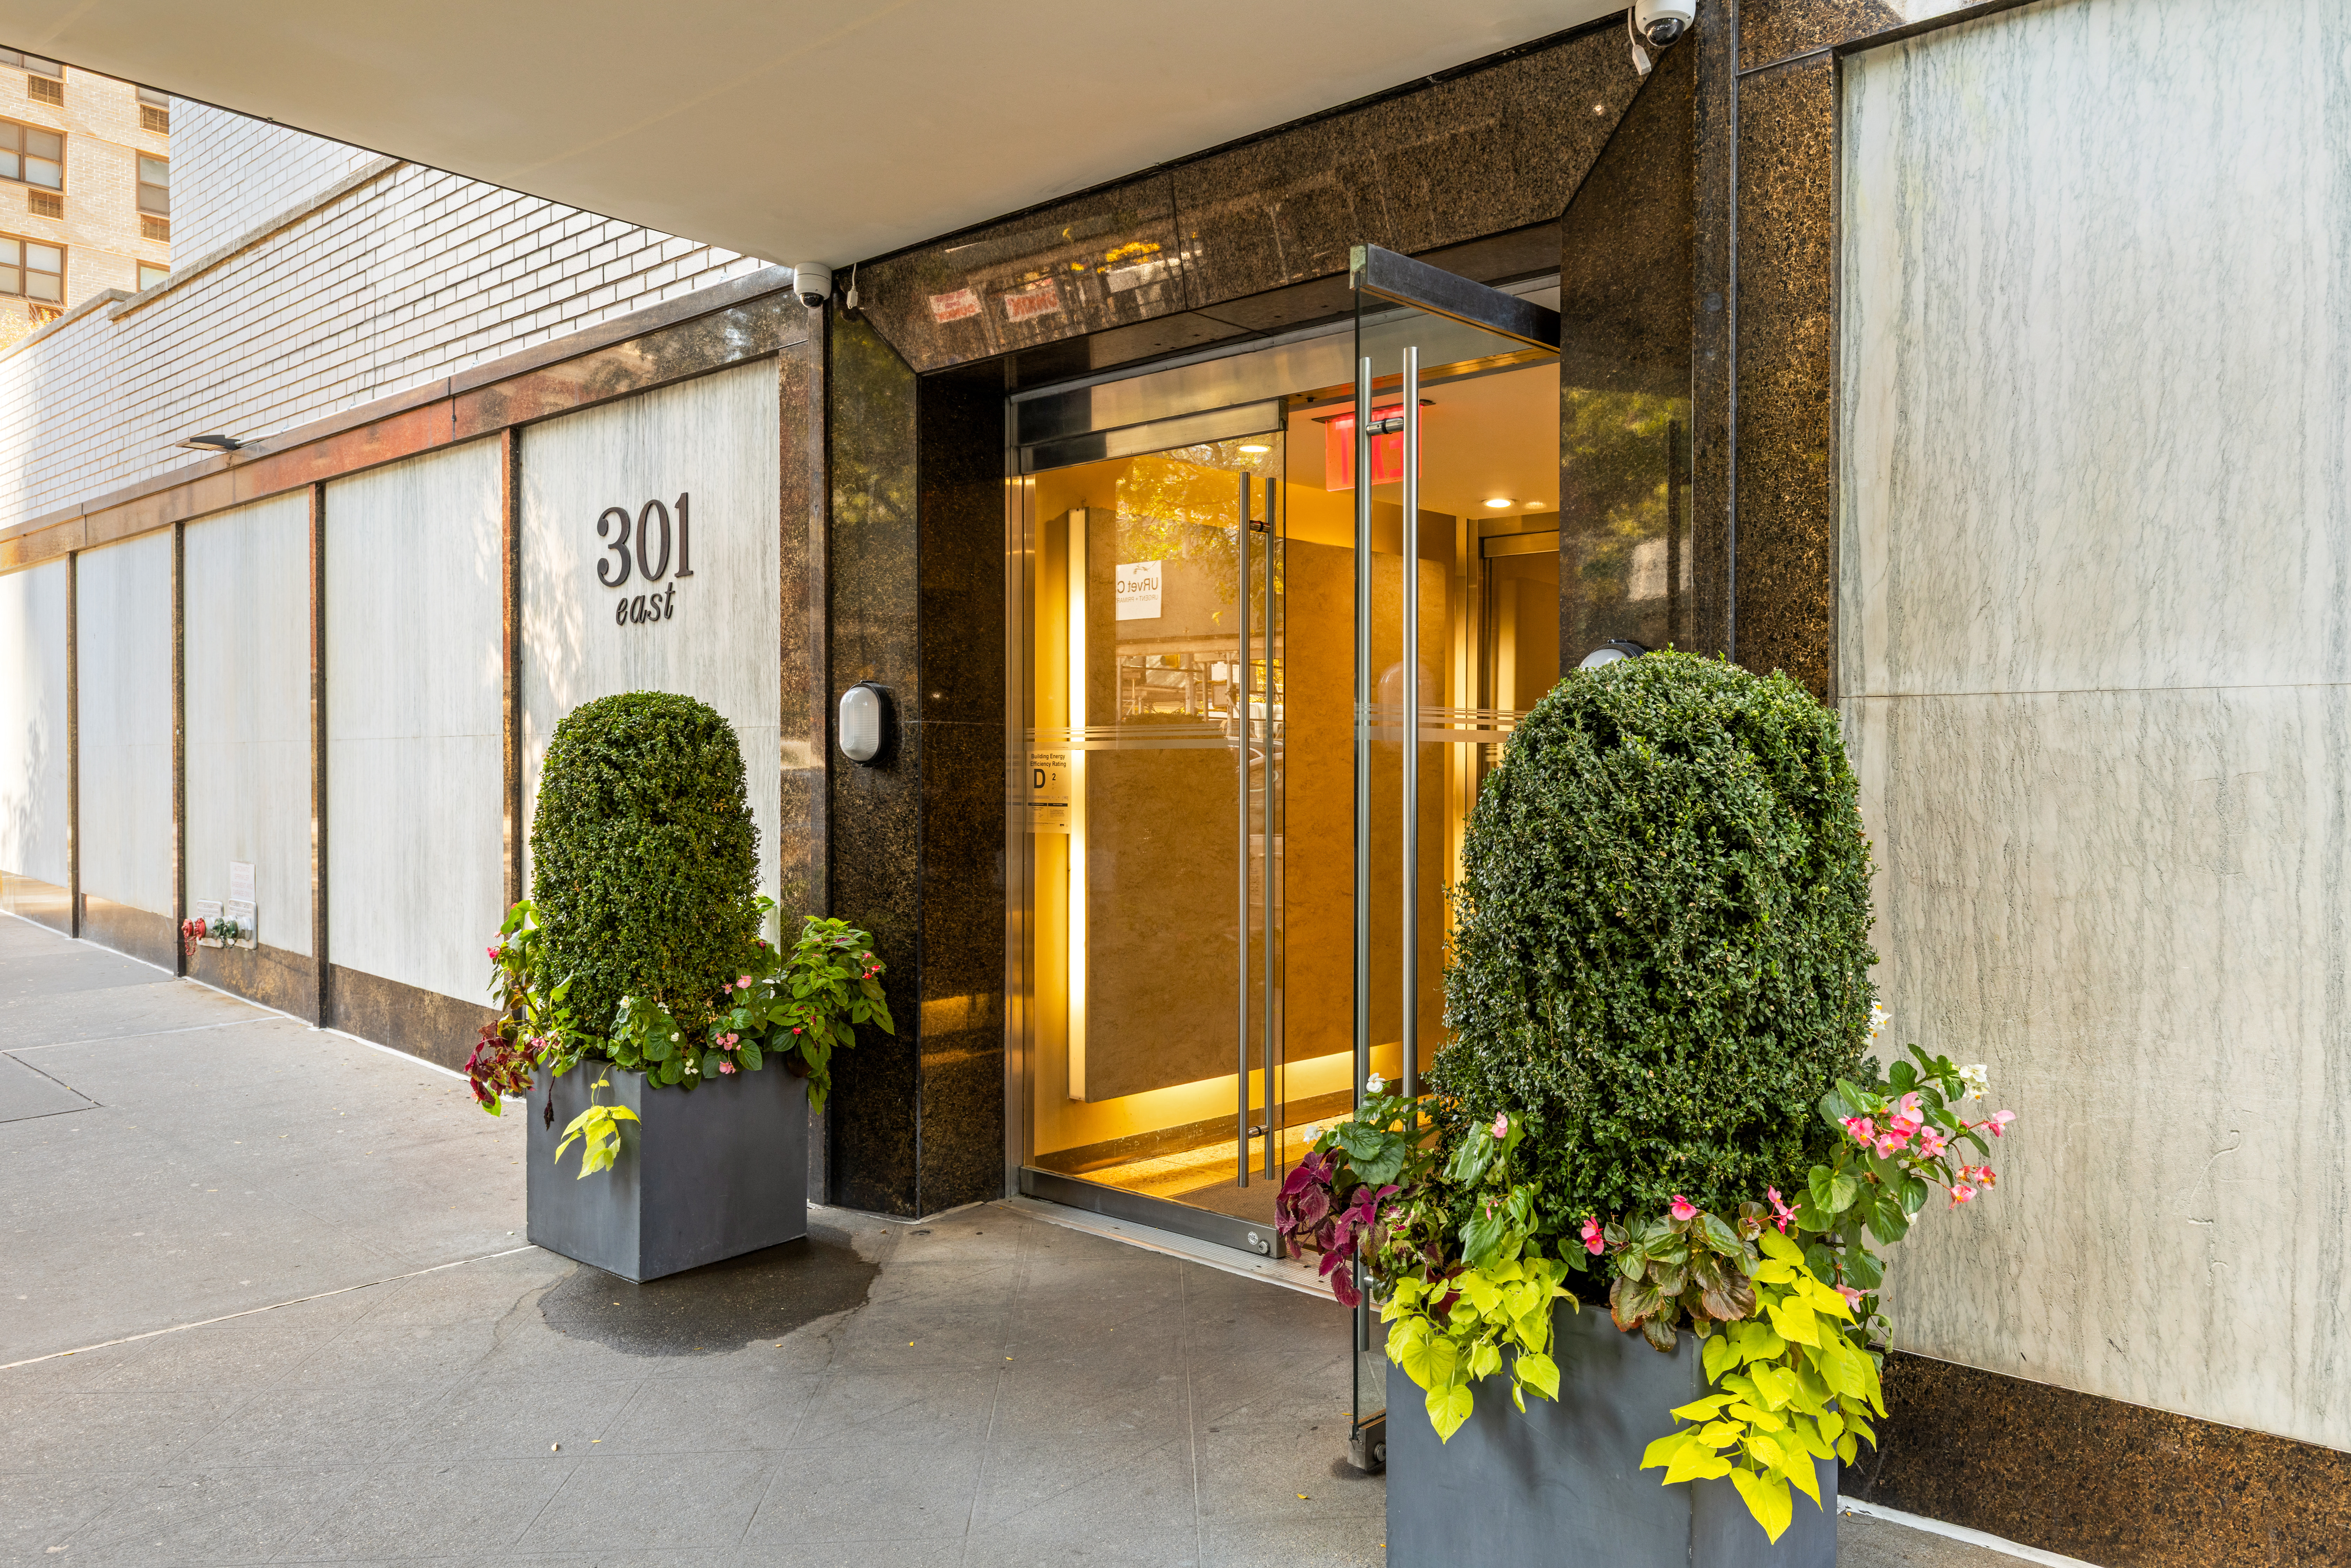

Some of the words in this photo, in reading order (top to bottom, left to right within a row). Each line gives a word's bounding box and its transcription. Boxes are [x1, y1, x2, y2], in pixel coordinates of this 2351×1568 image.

[597, 492, 693, 587] 301
[616, 582, 675, 625] east
[1034, 768, 1046, 789] D
